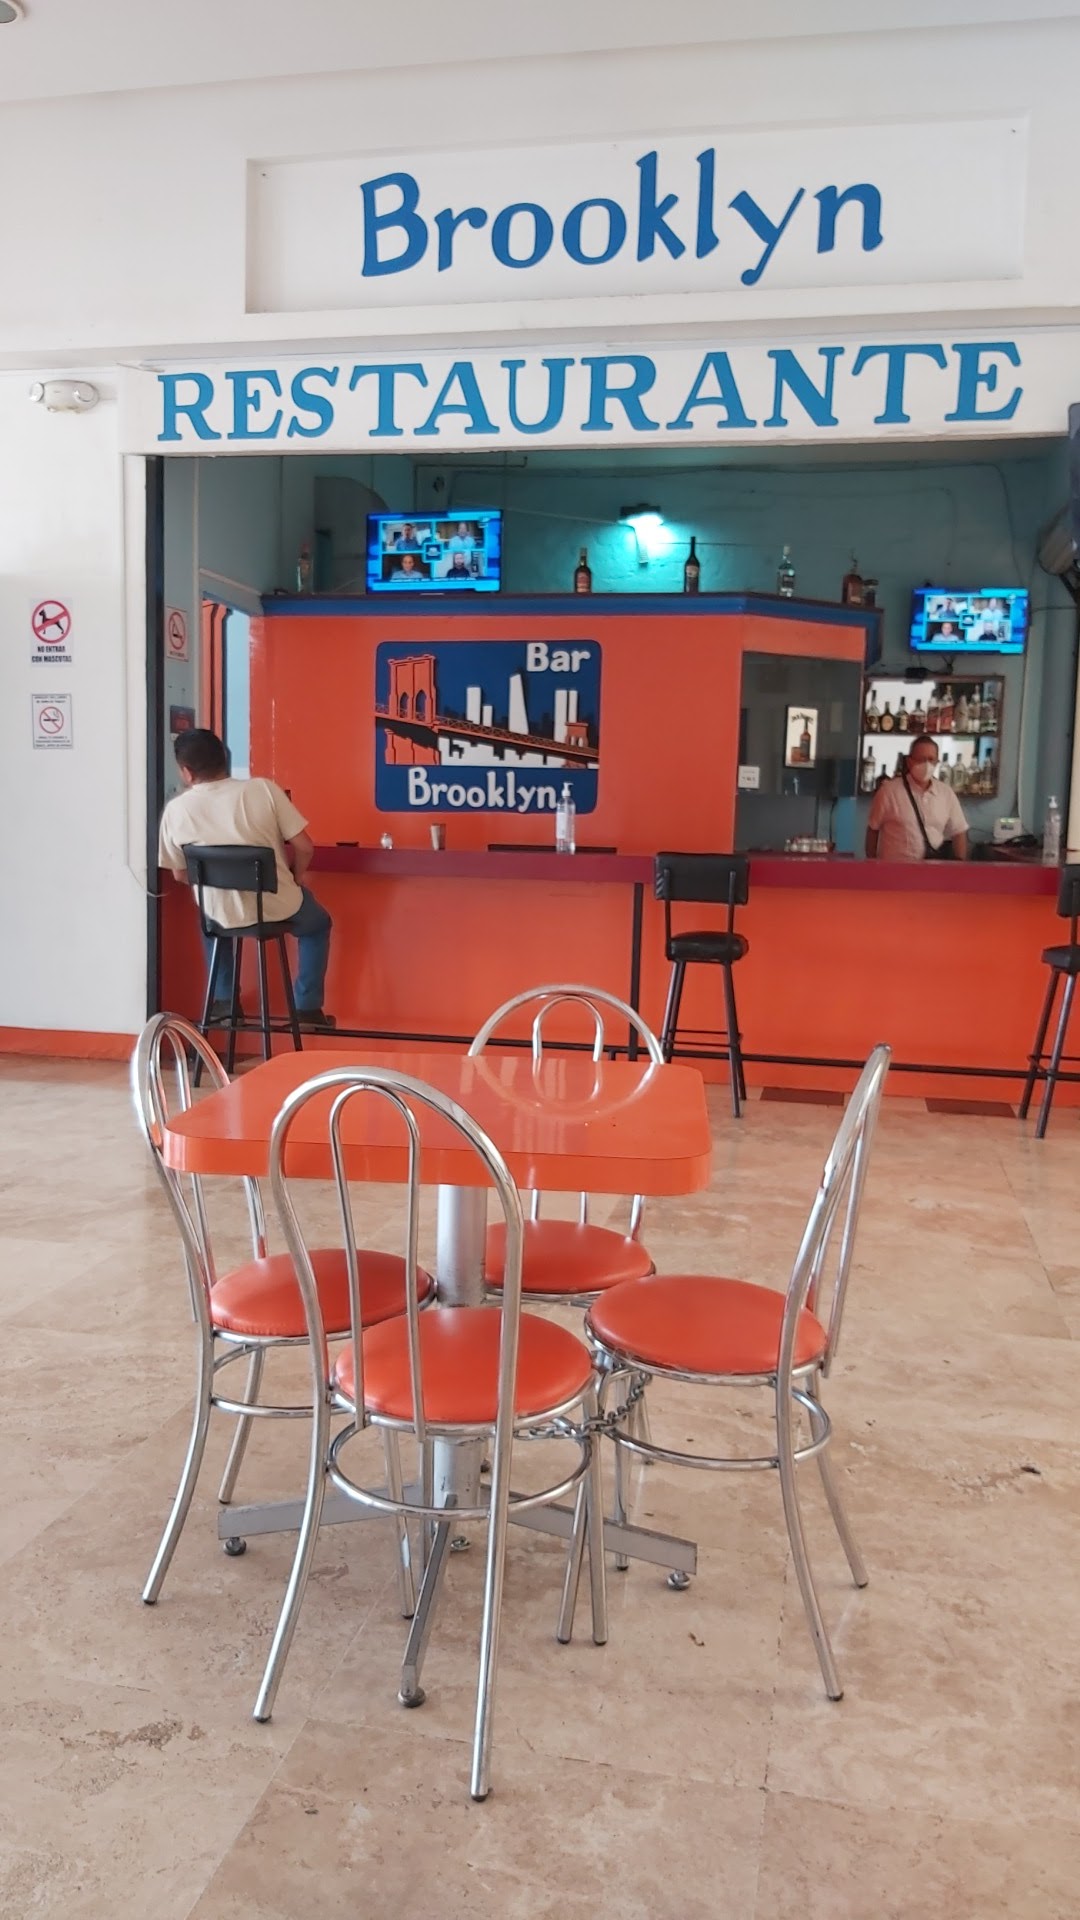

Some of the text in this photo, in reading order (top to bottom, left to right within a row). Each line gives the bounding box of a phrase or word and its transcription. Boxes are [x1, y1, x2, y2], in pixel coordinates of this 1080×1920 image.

[360, 148, 883, 286] Brooklyn
[158, 341, 1023, 441] RESTAURANTE
[31, 655, 43, 663] CON
[37, 645, 45, 653] NO
[526, 642, 591, 673] Bar
[408, 766, 557, 813] Brooklyn
